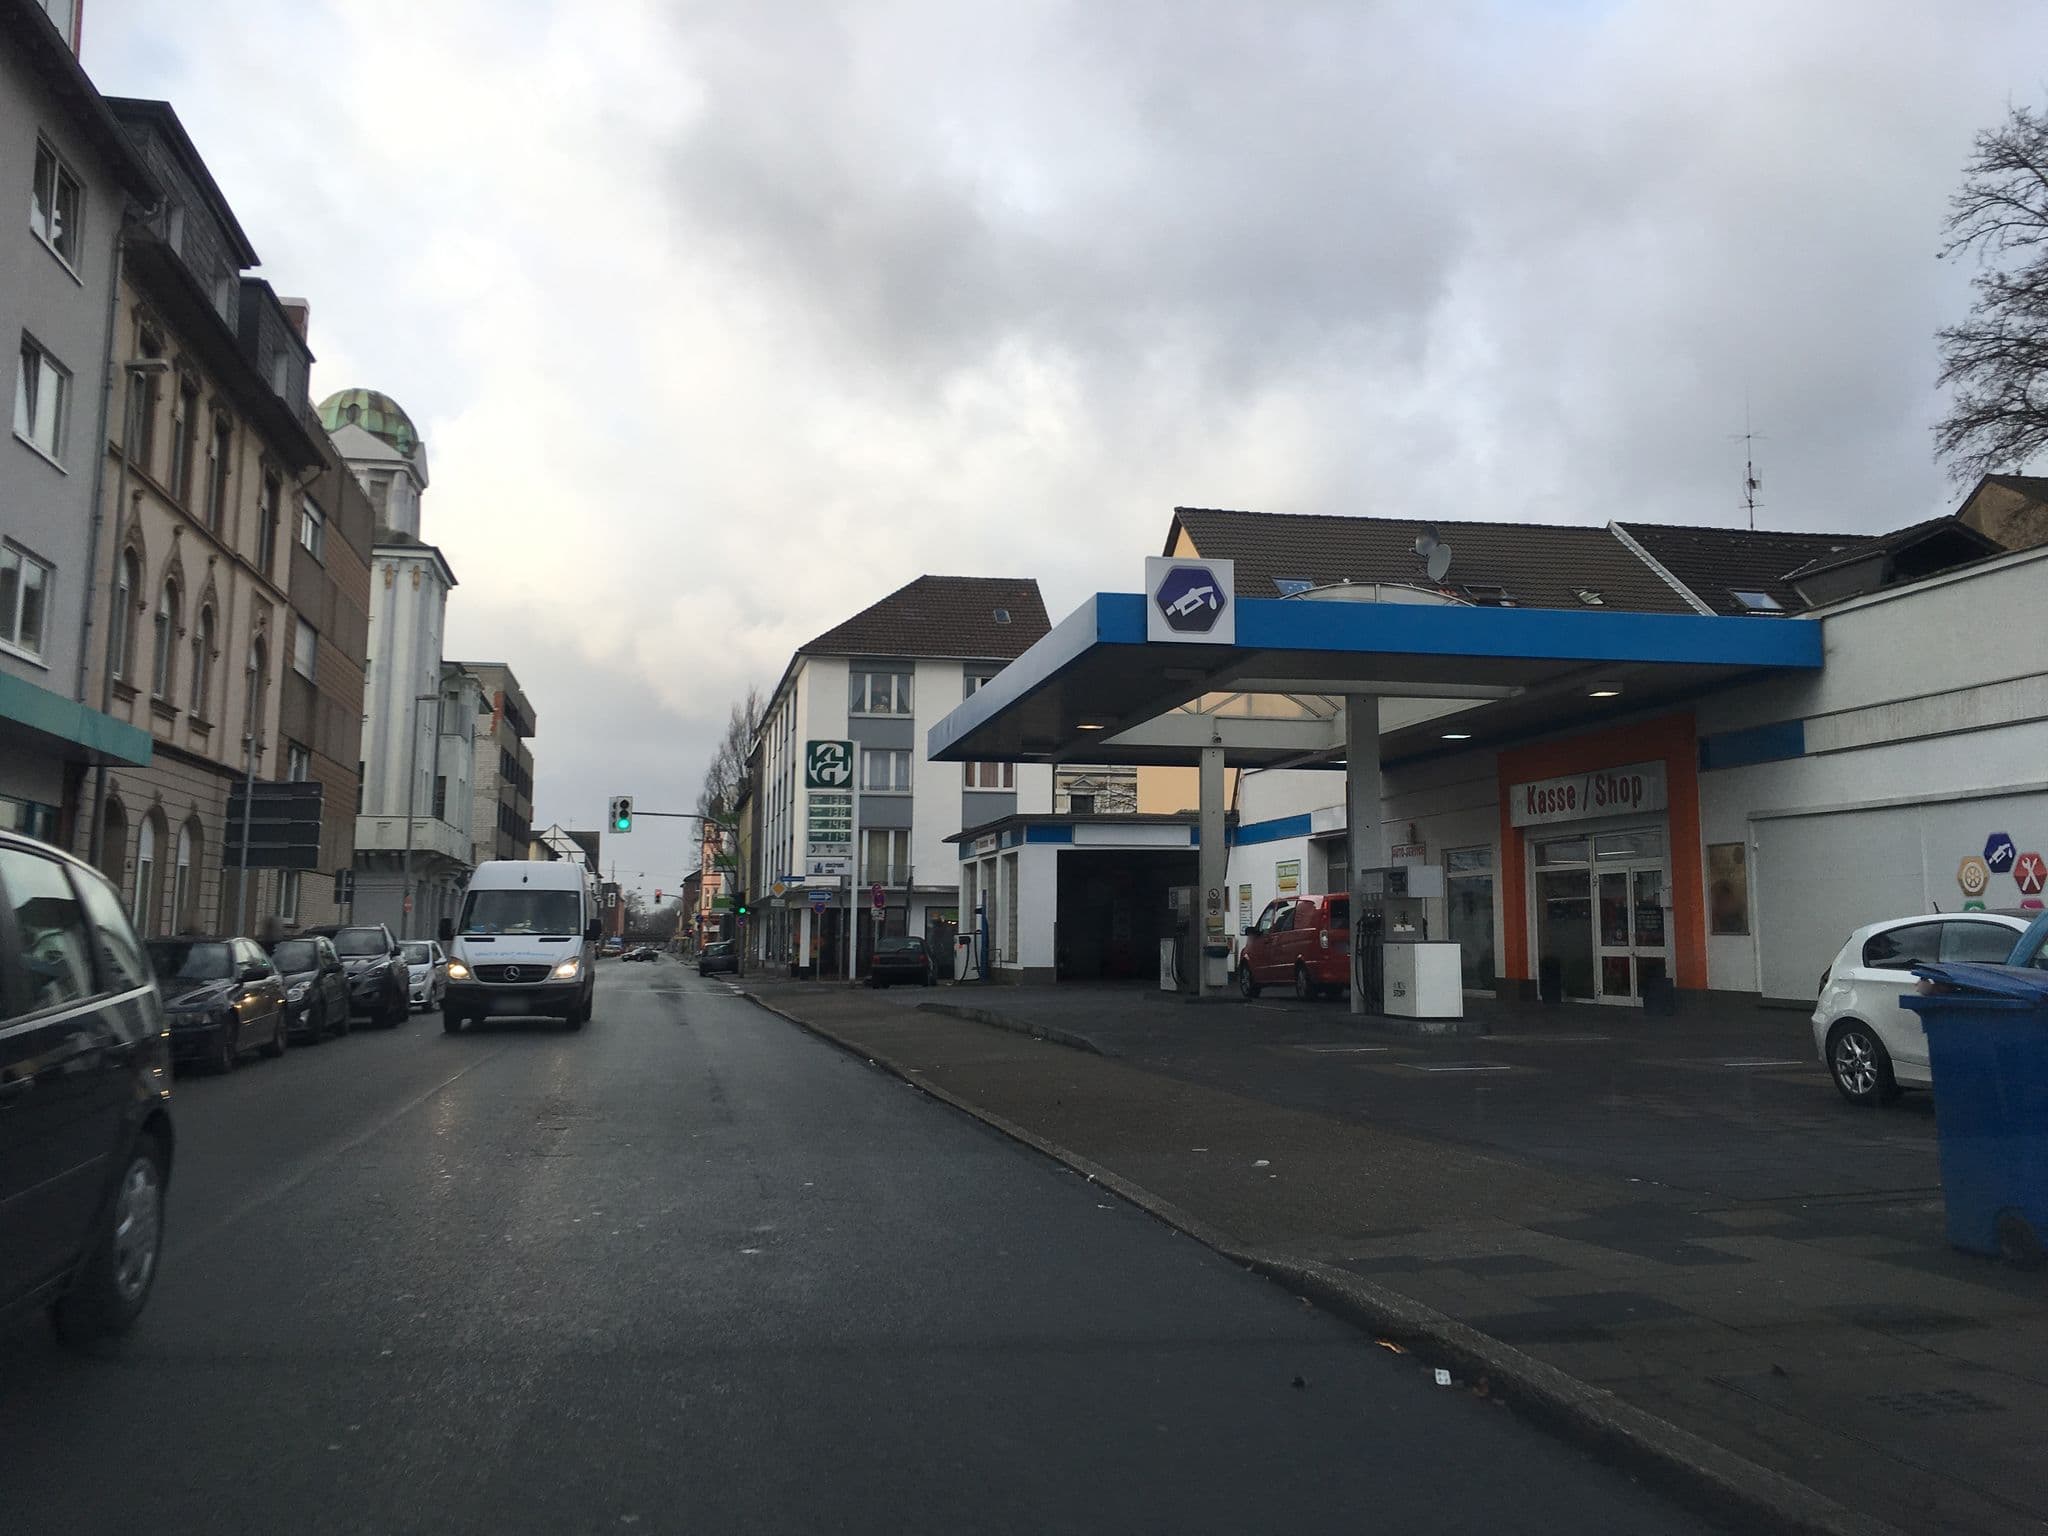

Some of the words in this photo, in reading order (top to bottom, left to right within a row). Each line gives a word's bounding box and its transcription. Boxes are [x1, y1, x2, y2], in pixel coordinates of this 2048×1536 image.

[1527, 784, 1576, 815] Kasse
[1595, 773, 1642, 809] Shop
[828, 819, 846, 830] 146
[828, 832, 846, 842] 119
